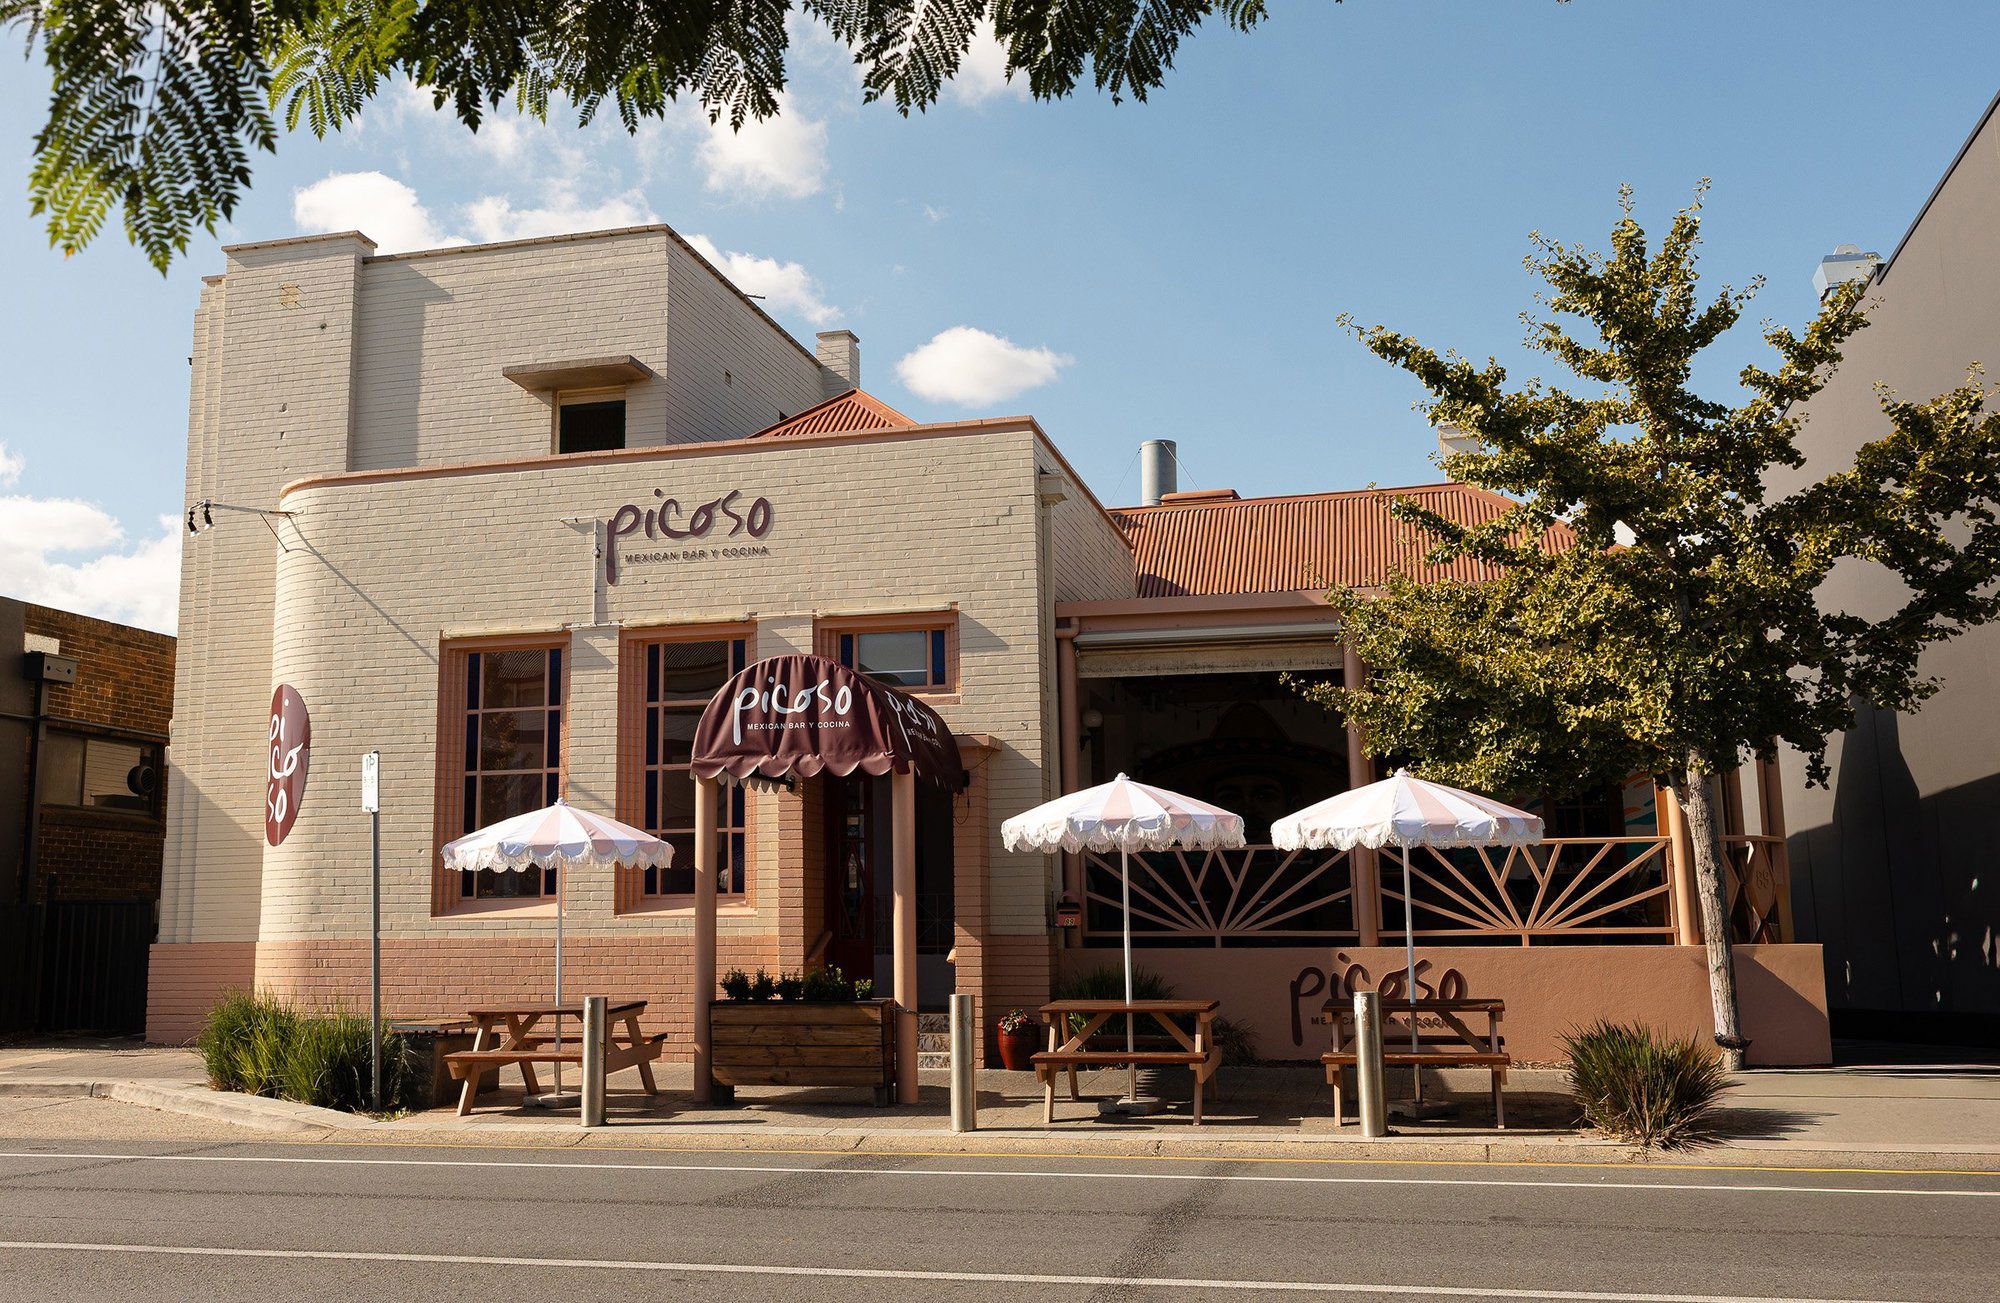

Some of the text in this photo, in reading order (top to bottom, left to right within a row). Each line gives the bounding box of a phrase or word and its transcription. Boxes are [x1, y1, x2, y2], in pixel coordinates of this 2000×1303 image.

[606, 488, 771, 585] picoso
[625, 546, 769, 563] MEXICAN BAR Y COCINA
[732, 676, 852, 746] picoso
